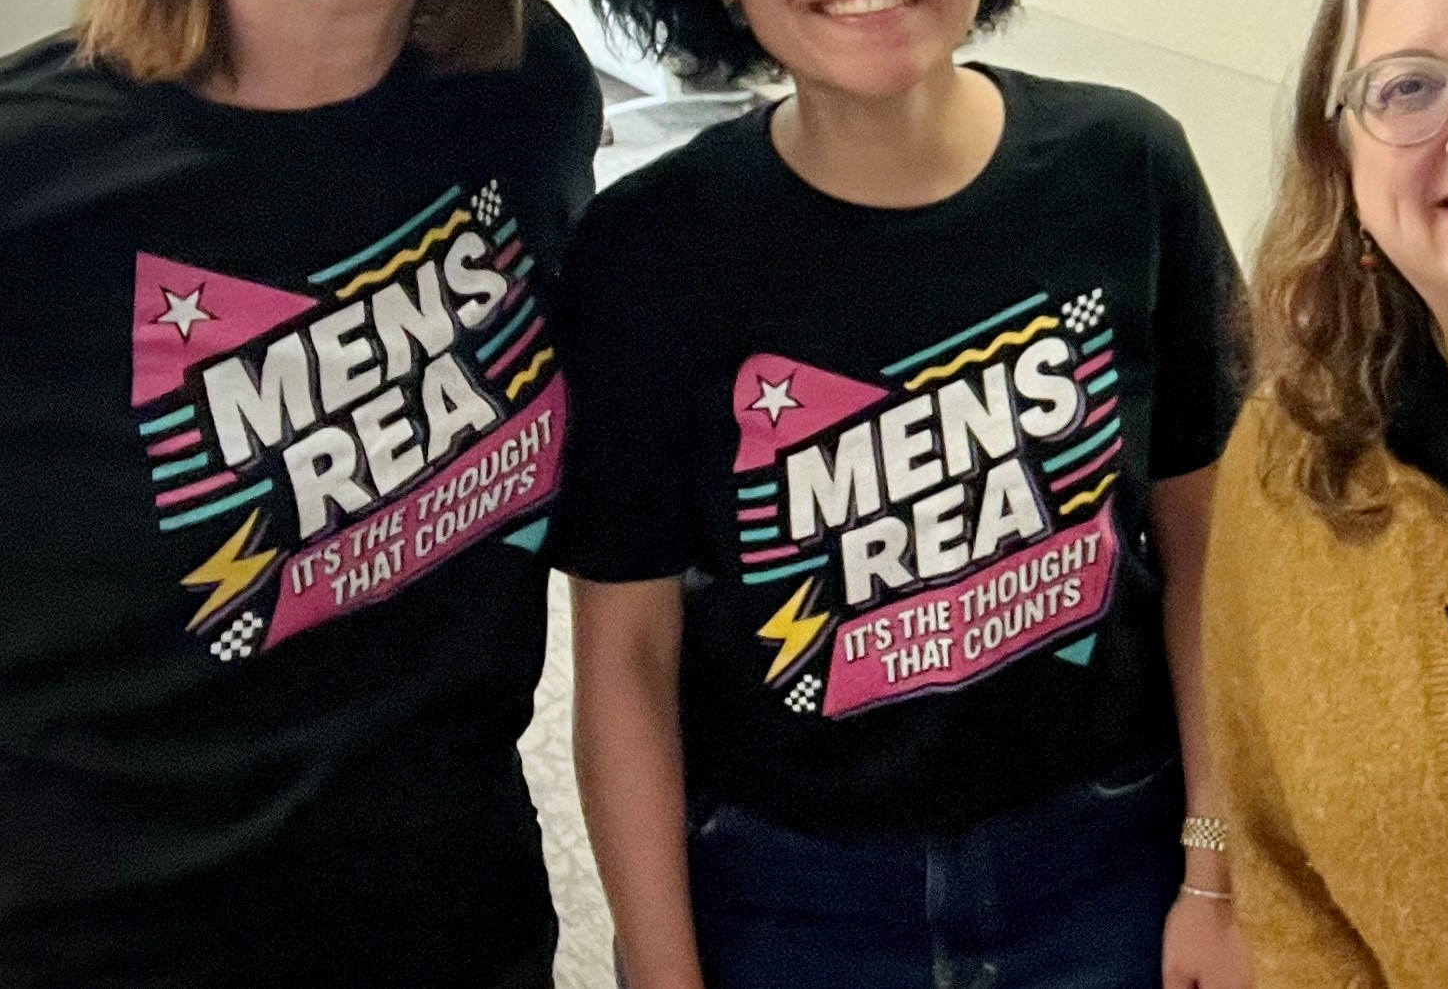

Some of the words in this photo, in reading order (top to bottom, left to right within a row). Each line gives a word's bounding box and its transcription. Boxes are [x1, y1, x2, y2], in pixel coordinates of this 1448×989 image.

[203, 231, 507, 467] MENS
[283, 353, 497, 540] REA
[291, 541, 341, 595] IT'S
[350, 507, 405, 558] THE
[417, 410, 552, 520] THOUGHT
[786, 337, 1079, 541] MENS
[330, 540, 405, 605] THAT
[415, 463, 538, 558] COUNTS
[841, 459, 1045, 606] REA
[844, 617, 893, 661] IT'S
[898, 601, 951, 639] THE
[958, 533, 1101, 623] THOUGHT
[881, 638, 953, 683] THAT
[963, 577, 1082, 660] COUNTS
